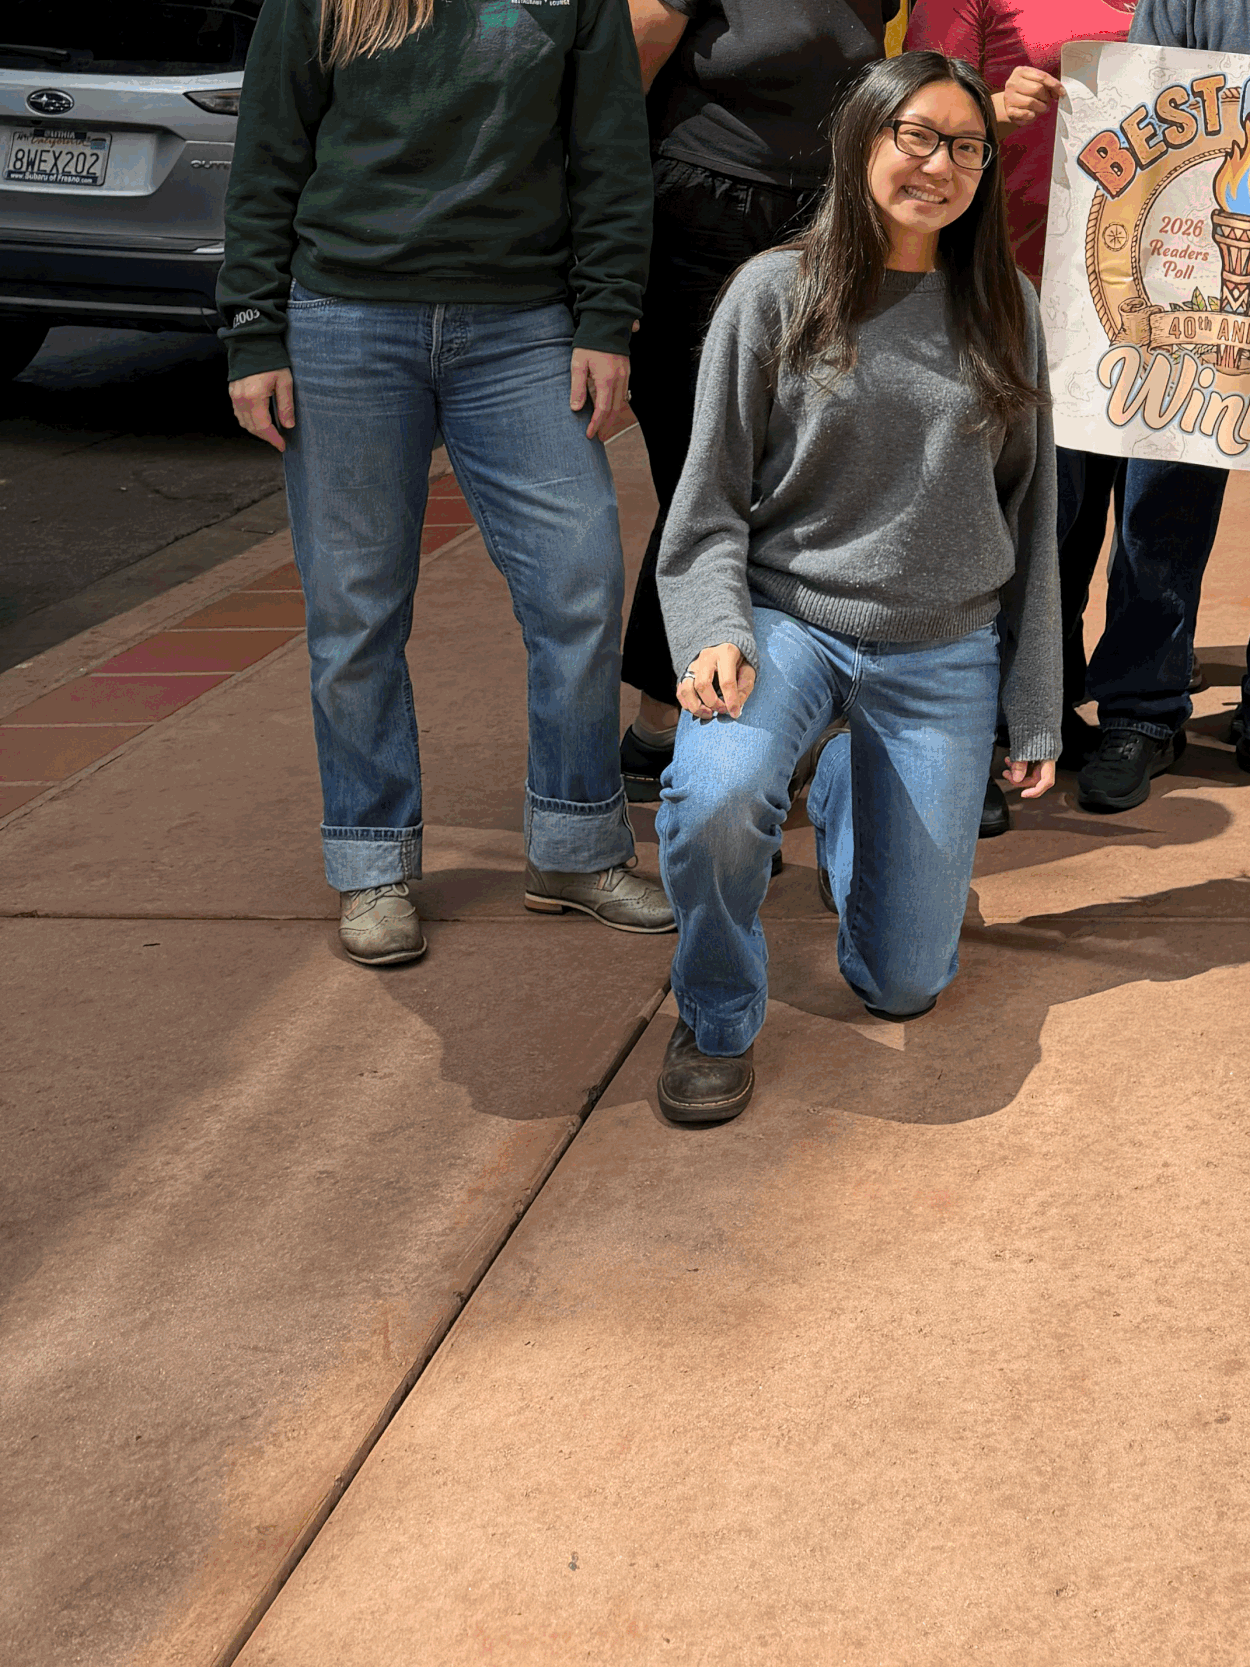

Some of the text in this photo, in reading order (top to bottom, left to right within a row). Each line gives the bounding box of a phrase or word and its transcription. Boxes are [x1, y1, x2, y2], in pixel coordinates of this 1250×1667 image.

[1076, 73, 1226, 200] BEST
[13, 148, 100, 176] 8WEX202
[24, 172, 49, 181] Subaru
[49, 173, 57, 182] of
[1158, 216, 1204, 238] 2026
[1149, 238, 1210, 262] Readers
[1162, 260, 1195, 280] Poll
[1168, 315, 1213, 339] 40th
